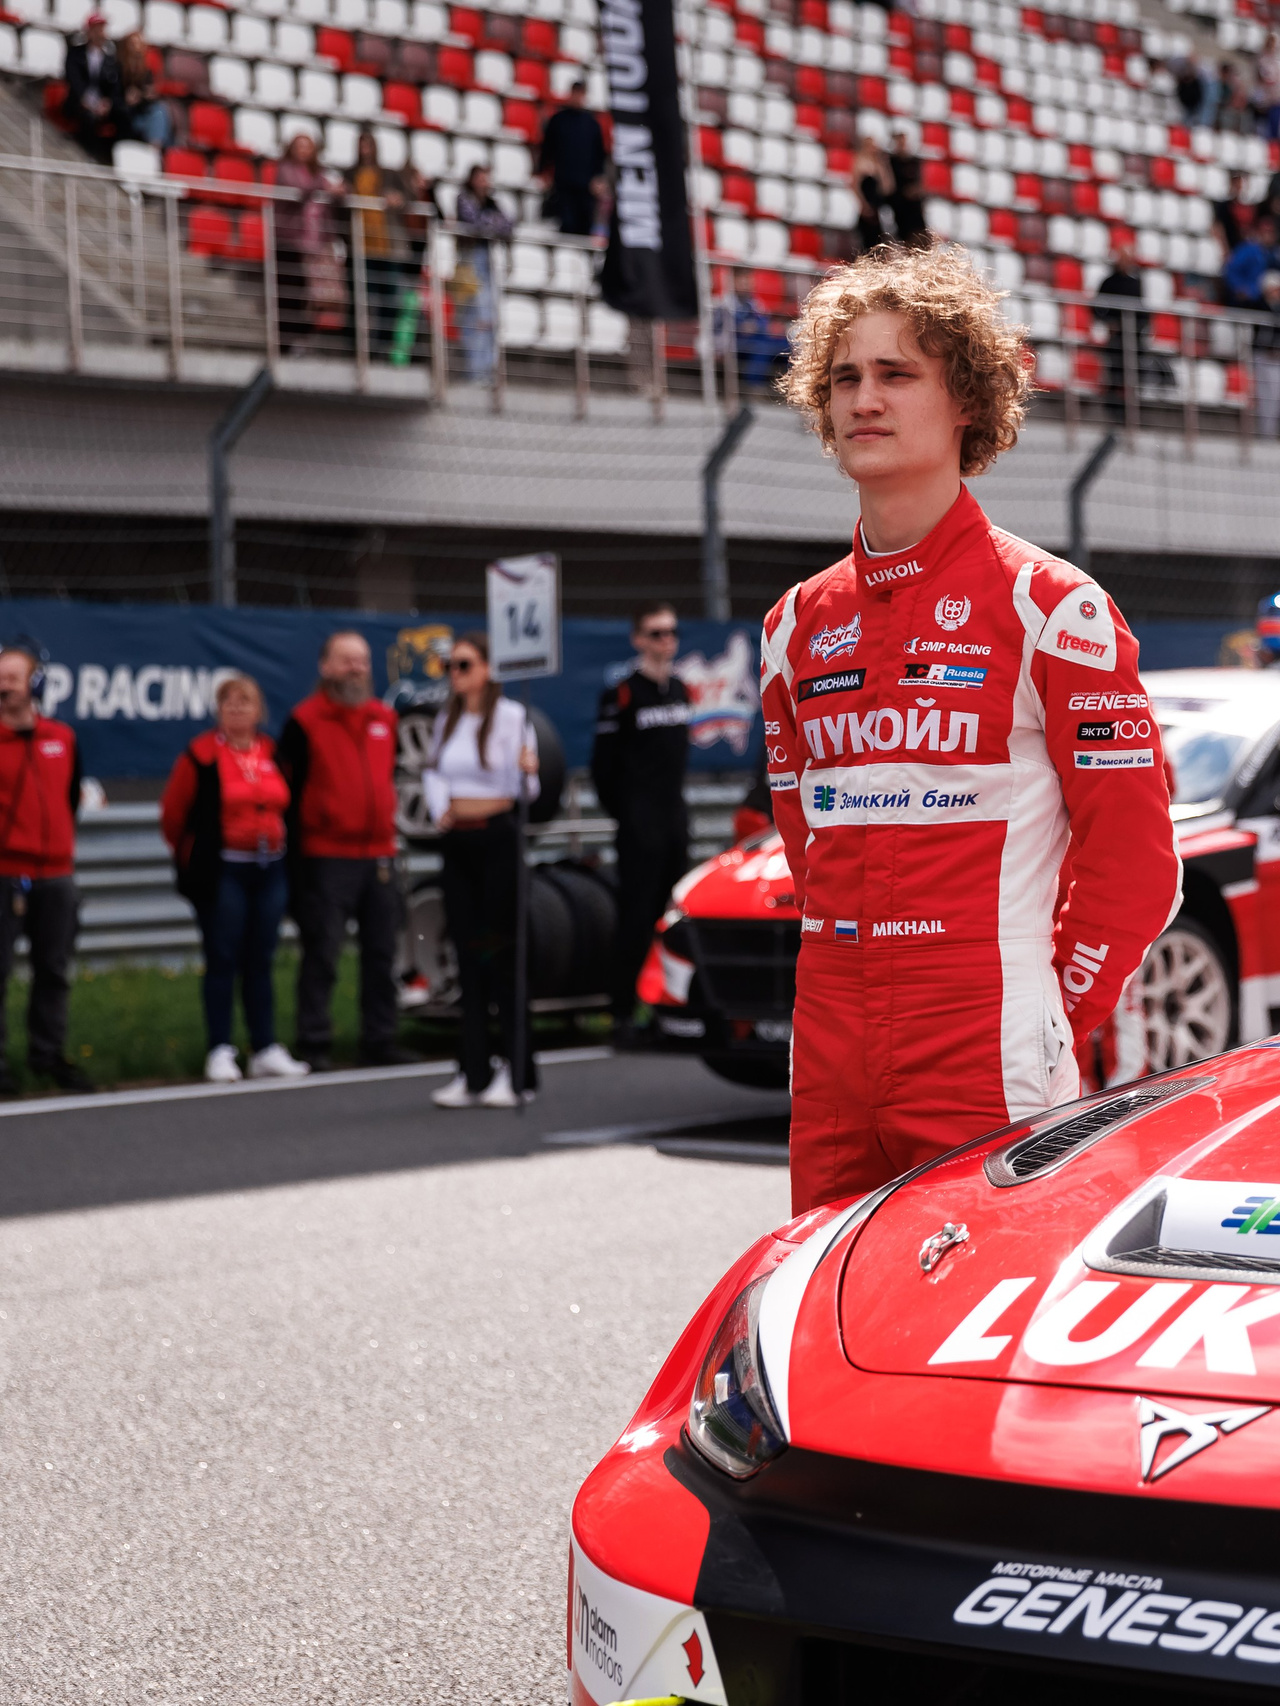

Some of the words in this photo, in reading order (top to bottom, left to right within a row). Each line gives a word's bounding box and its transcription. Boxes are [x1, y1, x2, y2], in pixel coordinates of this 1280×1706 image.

[612, 124, 663, 250] MEN
[864, 560, 924, 588] LUKOIL
[505, 602, 541, 643] 14
[919, 641, 945, 653] SMP
[946, 642, 991, 655] RACING
[1057, 629, 1107, 658] freem
[812, 673, 860, 693] YOKOHAMA
[904, 664, 947, 680] TCR
[946, 668, 985, 680] Russia
[1068, 694, 1148, 710] GENESIS
[803, 697, 980, 760] ЛУКОЙЛ
[1095, 756, 1134, 766] Земский
[1137, 756, 1152, 764] банк
[840, 789, 911, 810] Земский
[922, 789, 980, 808] банк
[872, 920, 946, 937] MIKHAIL
[991, 1561, 1093, 1584] МОТОРНЫЕ
[1094, 1571, 1163, 1592] МАСЛА
[590, 1606, 617, 1652] alarm
[589, 1638, 623, 1687] motors
